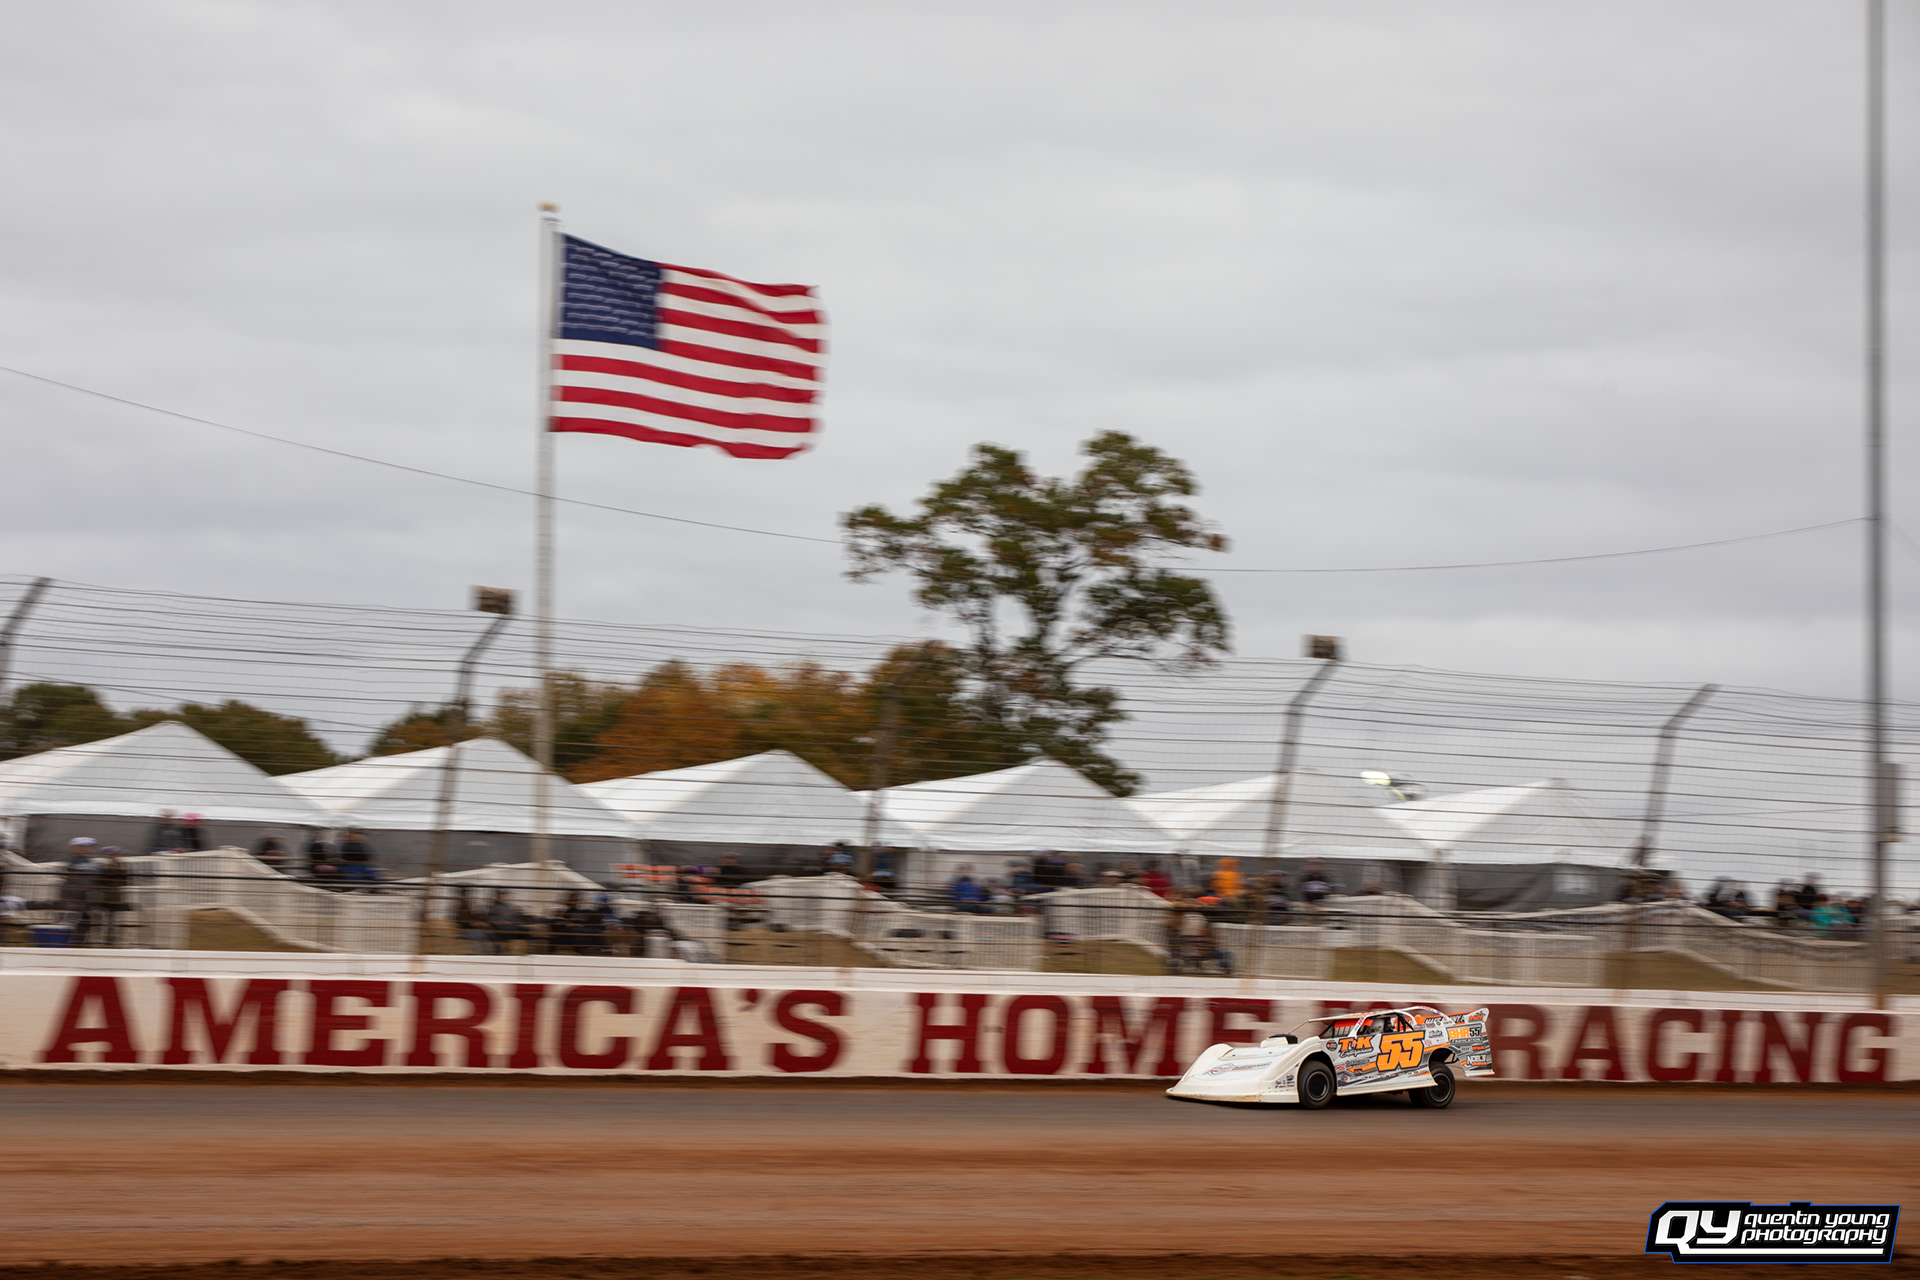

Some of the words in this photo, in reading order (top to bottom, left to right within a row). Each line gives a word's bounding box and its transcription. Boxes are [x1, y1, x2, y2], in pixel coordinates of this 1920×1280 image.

[42, 976, 849, 1074] AMERICA'S
[1484, 1003, 1886, 1084] RACING
[1377, 1031, 1425, 1072] 55
